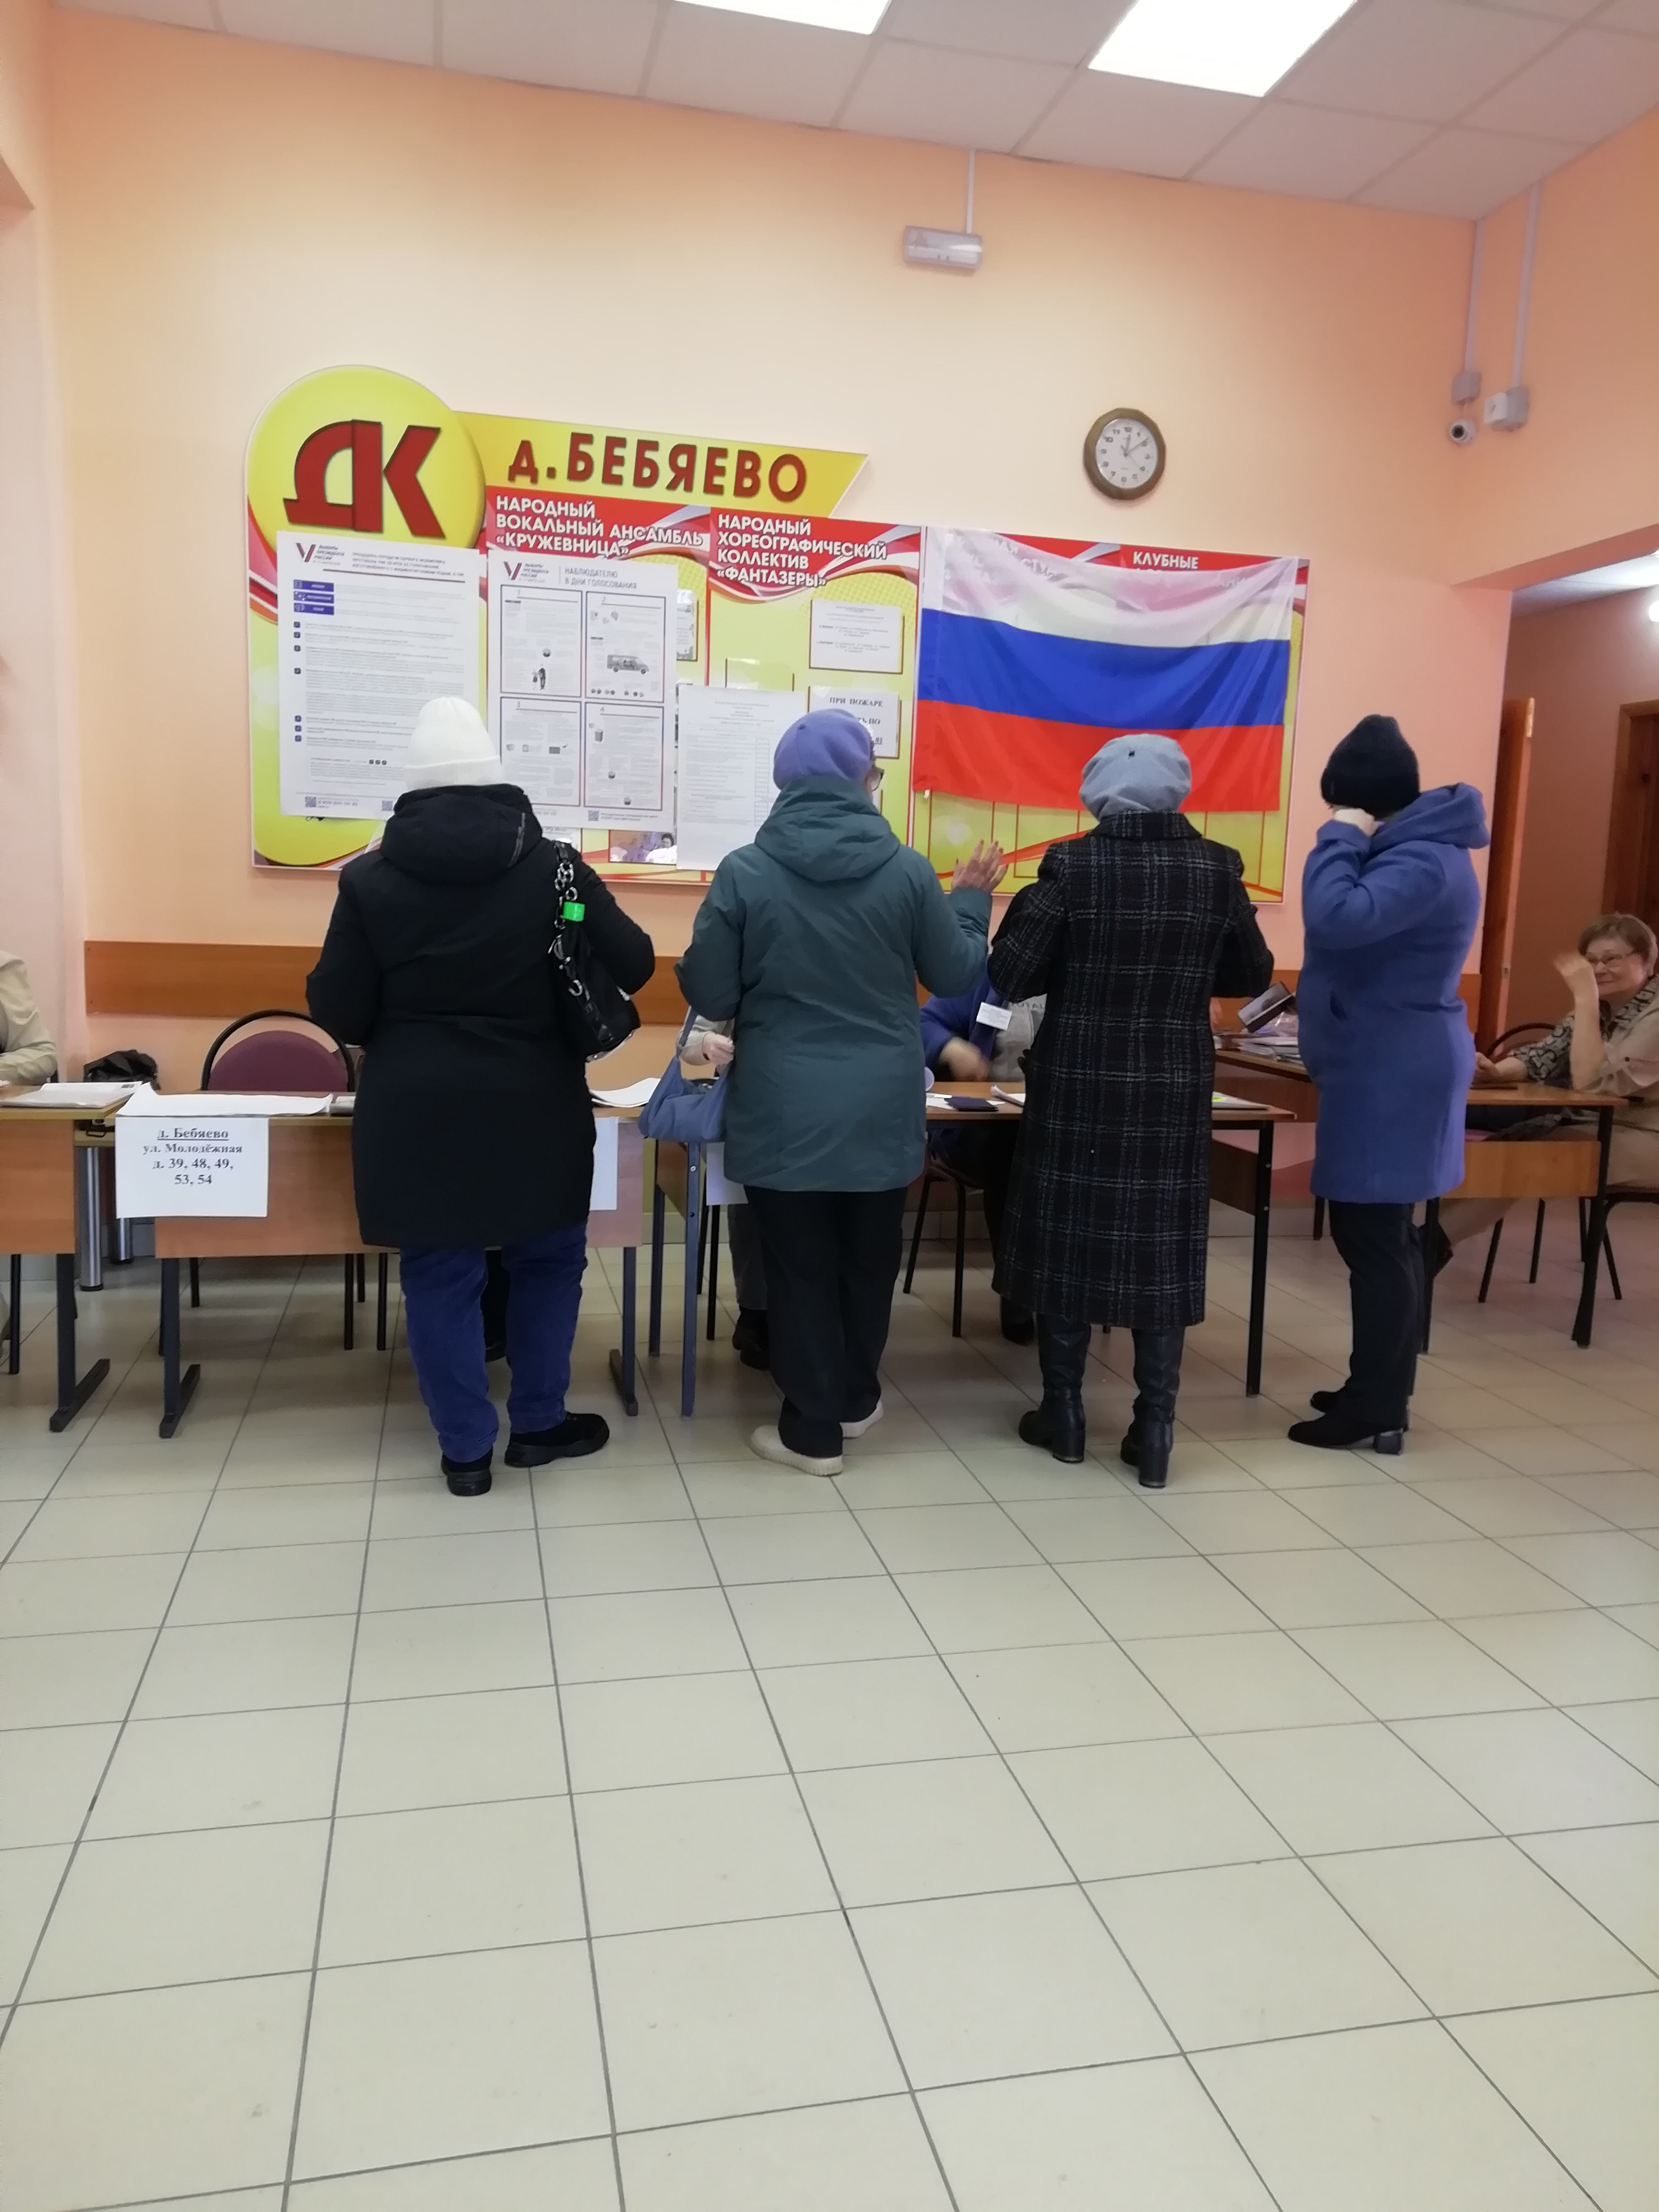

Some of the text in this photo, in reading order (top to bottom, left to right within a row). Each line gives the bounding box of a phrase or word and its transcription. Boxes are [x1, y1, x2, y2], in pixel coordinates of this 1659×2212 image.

[282, 420, 446, 539] ДК
[496, 495, 596, 519] НАРОДНЫЙ
[496, 513, 703, 546] ВОКАЛЬНЫЙ АНСАМБЛЬ
[718, 514, 811, 536] НАРОДНЫЙ
[496, 532, 630, 557] «КРУЖЕВНИЦА»
[717, 532, 887, 560] ХОРЕОГРАФИЧЕСКИЙ
[717, 548, 809, 570] КОЛЛЕКТИВ
[1133, 551, 1199, 570] КЛУБНЫЕ
[565, 567, 619, 579] НАБЛЮДАТЕЛЮ
[716, 567, 827, 588] «ФАНТАЗЕРЫ»
[588, 579, 638, 590] ГОЛОСОВАНИЯ
[850, 698, 883, 707] ПОЖАРЕ
[157, 1127, 229, 1139] д. Бебяево
[143, 1143, 243, 1155] ул. Молодёжная
[152, 1158, 234, 1170] д. 39, 48, 49,
[174, 1174, 213, 1186] 53, 54
